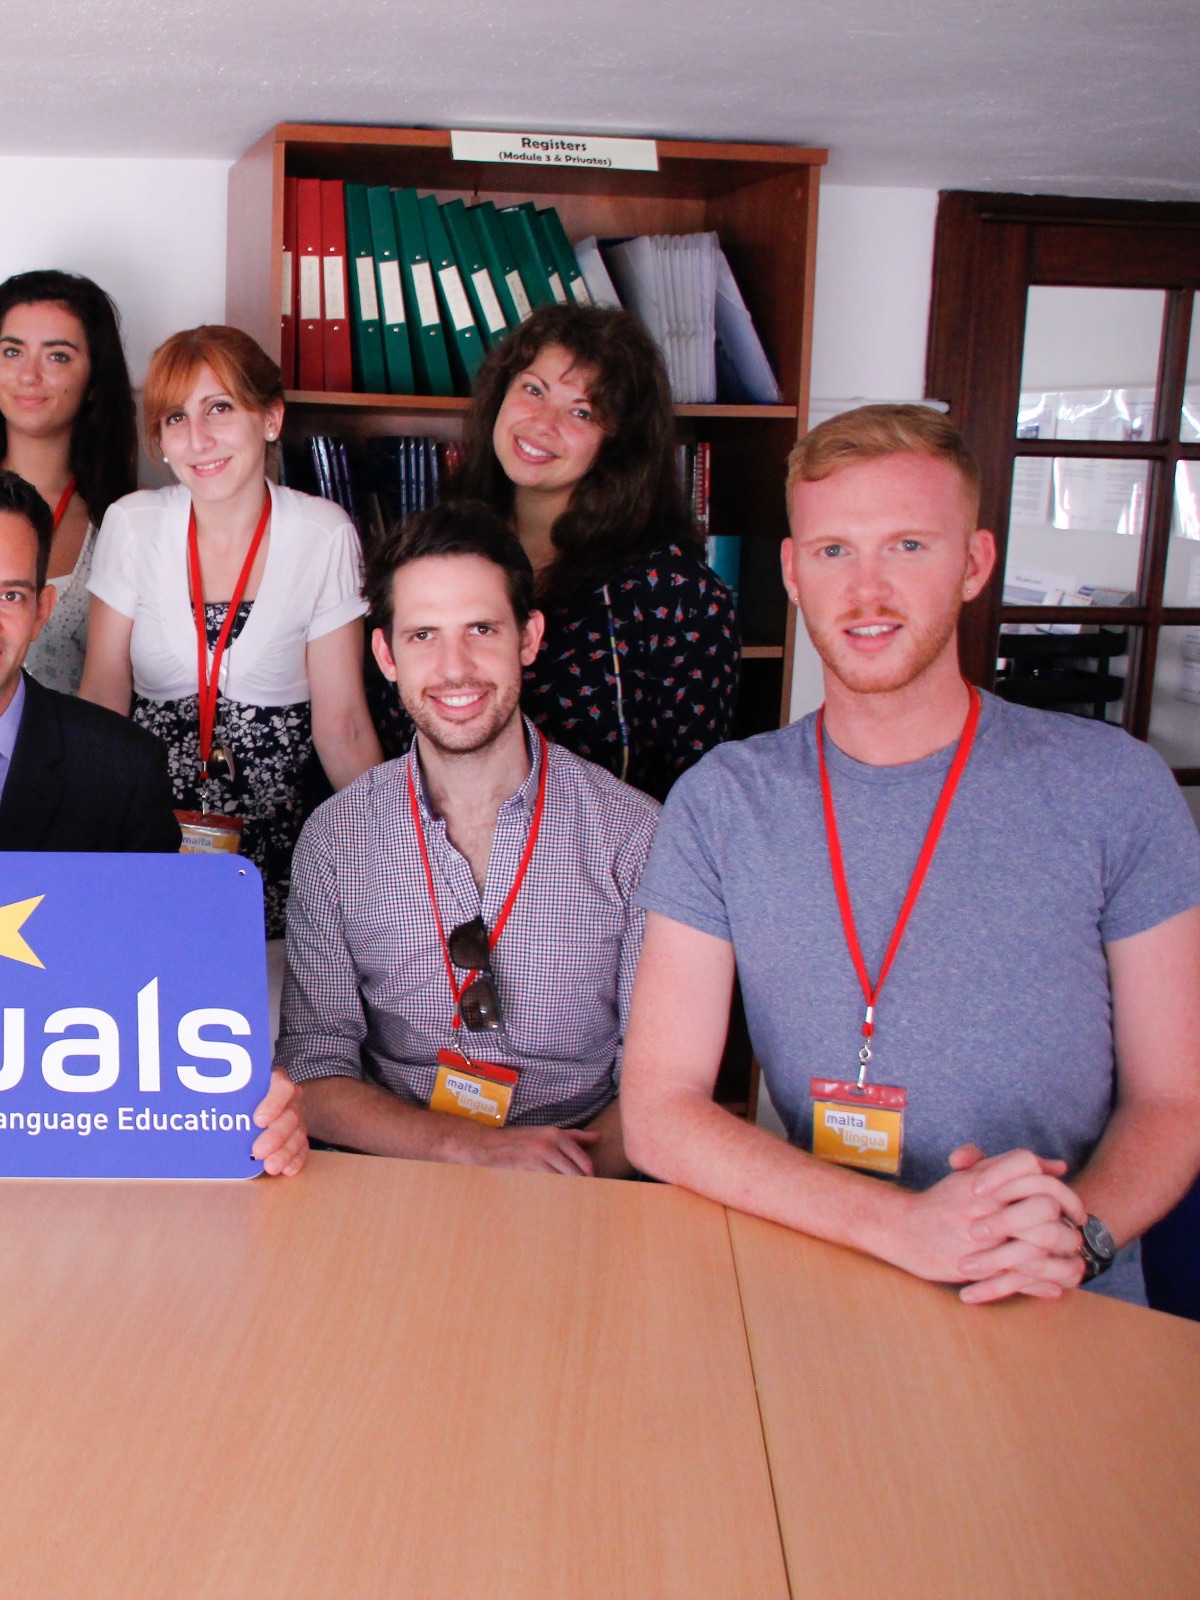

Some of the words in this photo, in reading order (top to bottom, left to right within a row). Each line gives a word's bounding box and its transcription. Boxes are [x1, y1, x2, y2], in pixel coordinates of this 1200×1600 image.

[521, 137, 587, 151] Registers
[499, 151, 542, 162] (Module
[545, 154, 551, 162] 3
[554, 154, 562, 162] &
[565, 154, 612, 167] Privates)
[182, 836, 211, 847] malta
[447, 1078, 480, 1094] malta
[460, 1095, 495, 1113] lingua
[118, 1107, 251, 1132] Education
[826, 1113, 864, 1128] malta
[845, 1131, 886, 1147] lingua
